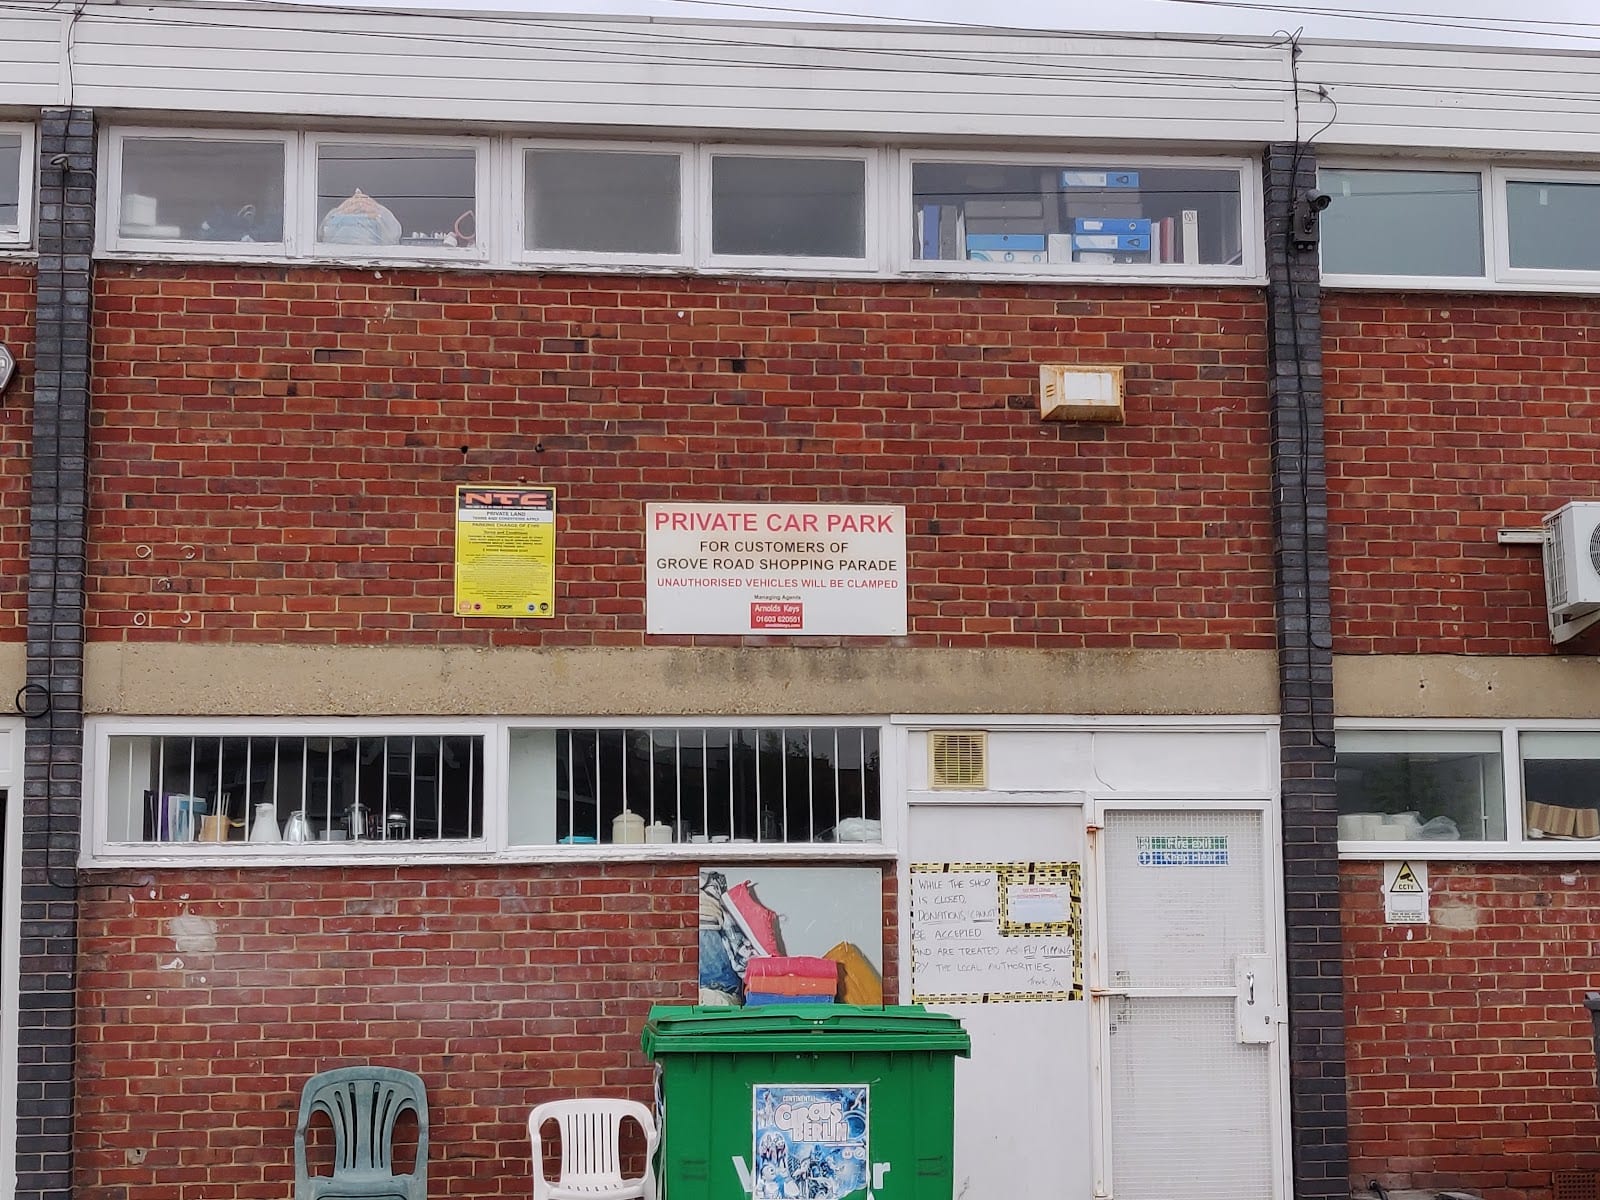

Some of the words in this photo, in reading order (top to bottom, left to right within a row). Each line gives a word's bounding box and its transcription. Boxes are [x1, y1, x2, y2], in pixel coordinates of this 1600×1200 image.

[465, 493, 547, 505] NTC
[655, 512, 758, 531] PRIVATE
[766, 513, 818, 532] CAR
[827, 514, 894, 533] PARK
[700, 541, 729, 552] FOR
[734, 541, 825, 553] CUSTOMERS
[829, 542, 849, 553] OF
[656, 558, 708, 570] GROVE
[713, 559, 755, 570] ROAD
[759, 559, 834, 570] SHOPPING
[839, 560, 897, 571] PARADE
[657, 578, 742, 587] UNAUTHORISED
[745, 579, 798, 588] VEHICLES
[801, 579, 826, 588] WILL
[829, 580, 844, 588] BE
[847, 580, 898, 589] CLAMPED
[755, 604, 781, 612] Arnolds
[783, 604, 800, 614] Keys
[756, 615, 777, 623] 01603
[919, 880, 942, 890] WHILE
[948, 879, 964, 889] THE
[969, 879, 991, 888] SHOP
[918, 896, 928, 905] IS
[913, 930, 925, 940] BE
[935, 928, 982, 939] ACCEPTED
[914, 948, 932, 956] AND
[938, 948, 955, 956] ARE
[958, 946, 1000, 956] TREATED
[1006, 945, 1018, 954] AS
[1024, 945, 1038, 954] FLY
[1040, 945, 1073, 955] TIPPING
[914, 961, 929, 974] BY
[936, 964, 952, 973] THE
[957, 963, 982, 972] LOCAL
[774, 1102, 843, 1131] CIRCUS
[792, 1121, 848, 1142] BERLIN
